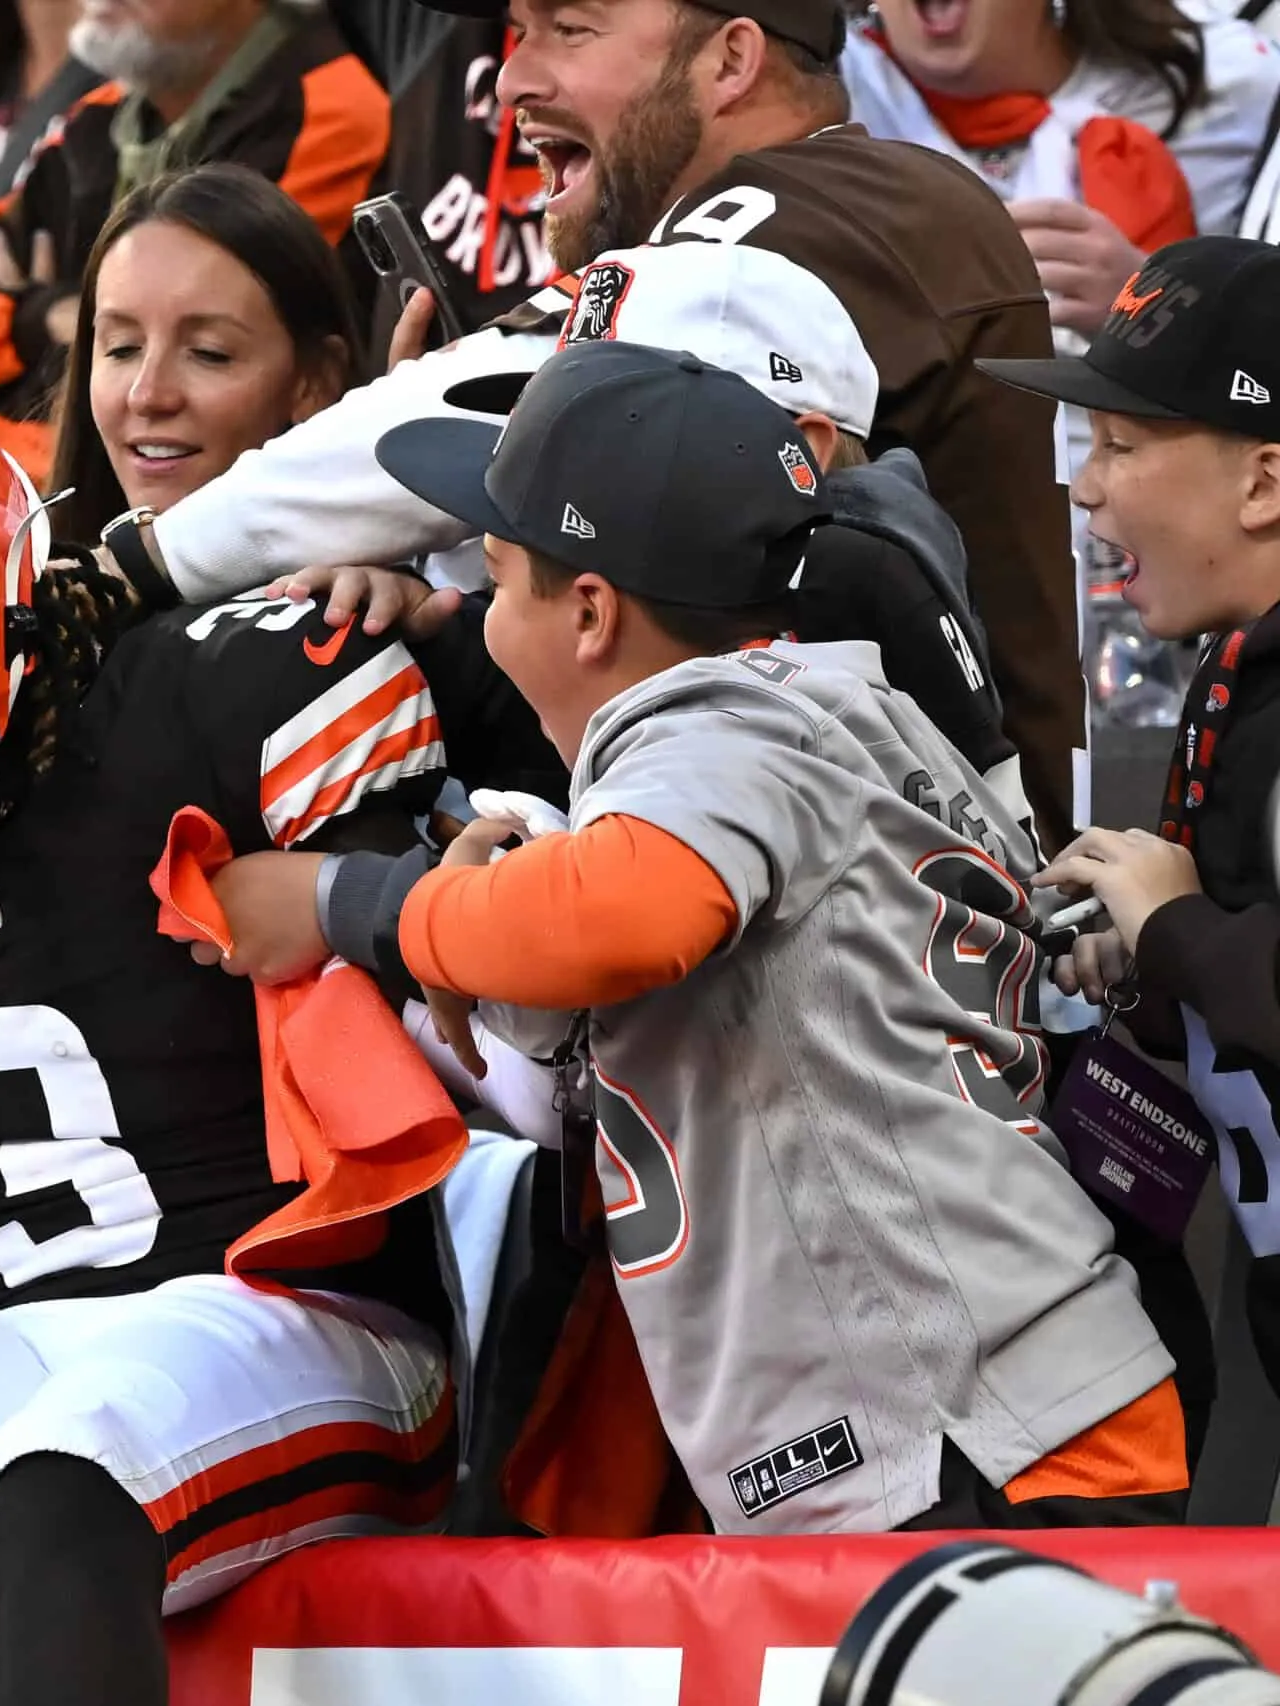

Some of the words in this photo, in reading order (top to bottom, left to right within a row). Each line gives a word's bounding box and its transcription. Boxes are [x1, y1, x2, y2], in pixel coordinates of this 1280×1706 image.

[1086, 1057, 1131, 1101] WEST
[1129, 1091, 1209, 1157] ENDZONE
[787, 1447, 805, 1469] L
